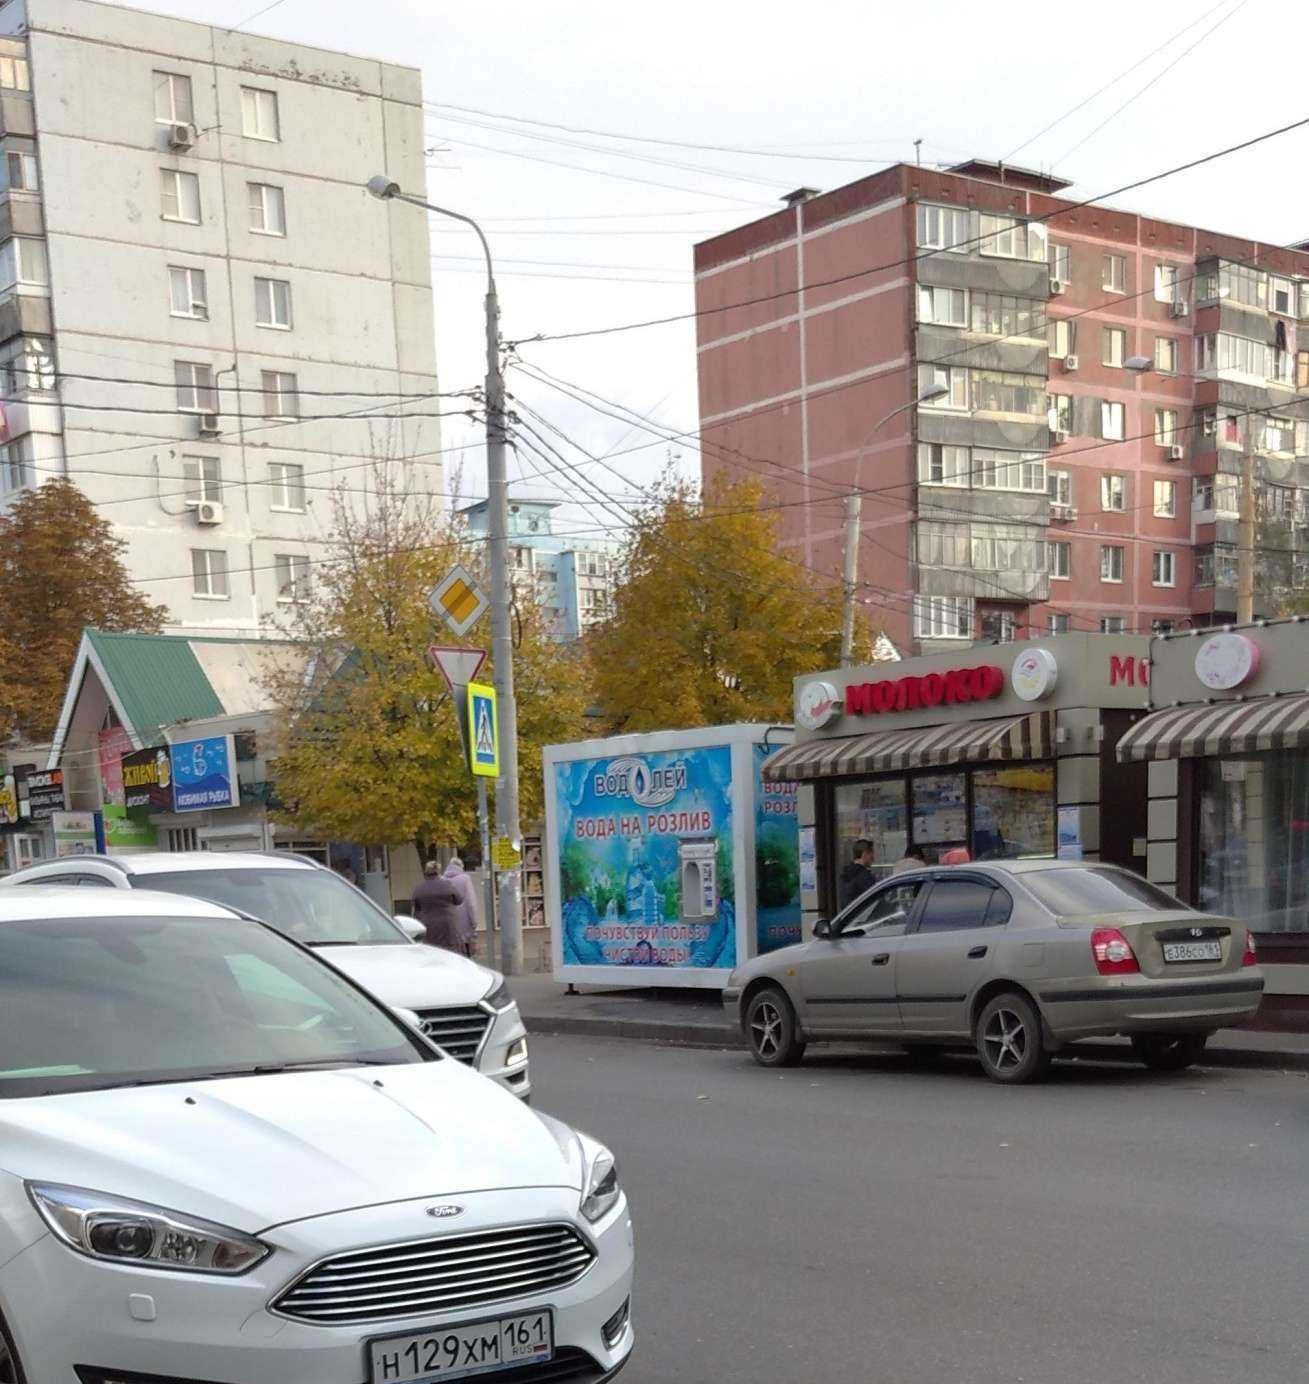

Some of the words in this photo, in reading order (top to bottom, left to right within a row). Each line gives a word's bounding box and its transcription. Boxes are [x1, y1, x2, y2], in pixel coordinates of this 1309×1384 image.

[845, 665, 1004, 718] МОЛОКО
[575, 819, 616, 839] ВОДА
[620, 816, 642, 836] НА
[647, 811, 712, 834] РОЗЛИВ
[382, 1335, 499, 1379] Н129ХМ
[504, 1317, 546, 1346] 161
[512, 1345, 534, 1356] RUS
